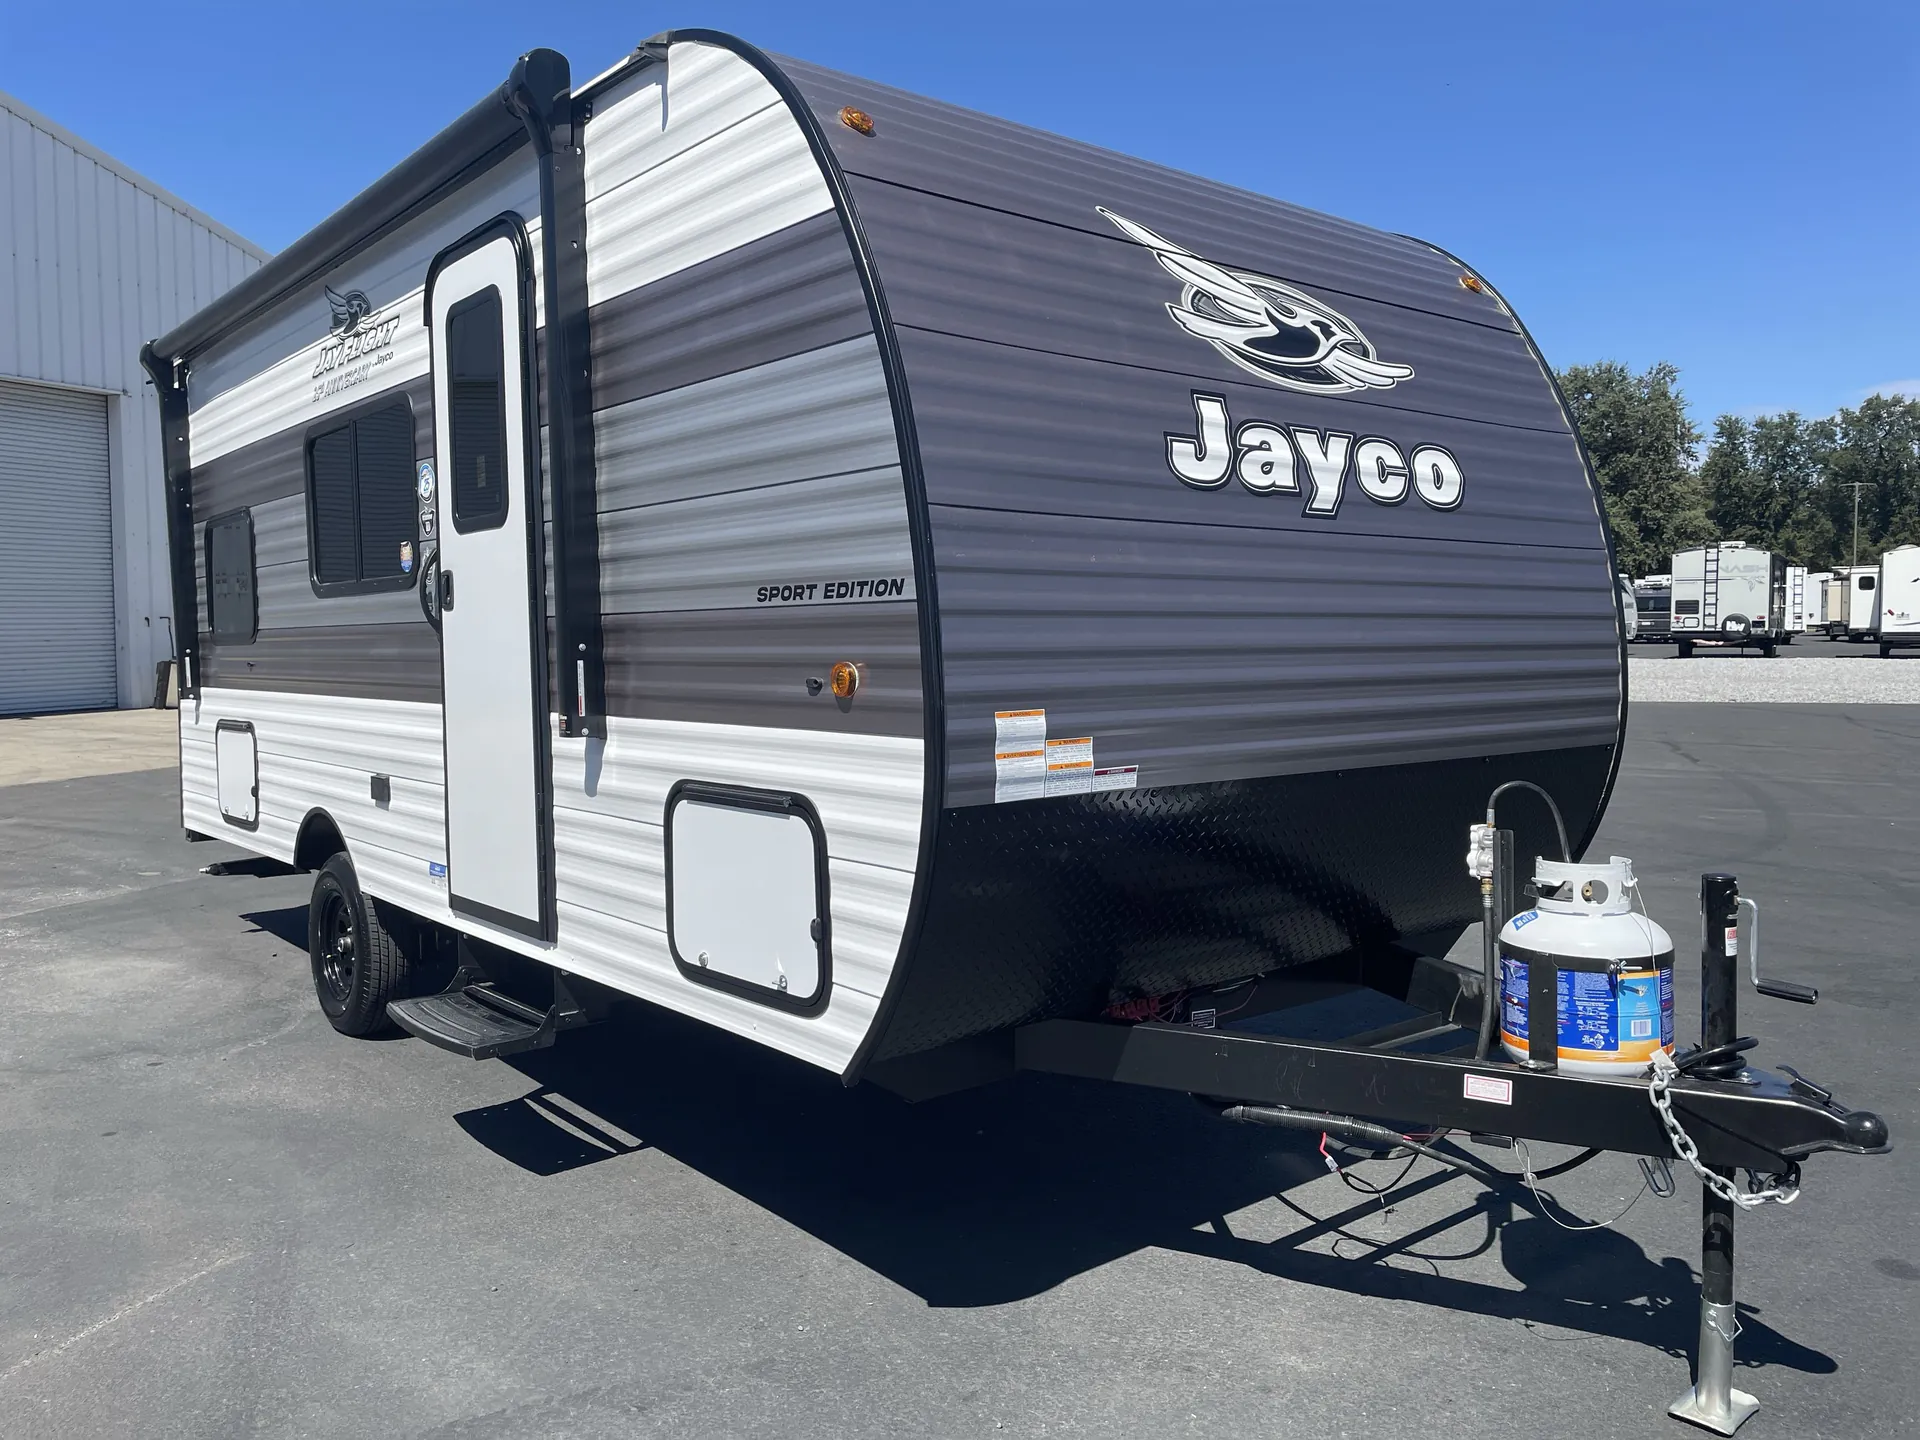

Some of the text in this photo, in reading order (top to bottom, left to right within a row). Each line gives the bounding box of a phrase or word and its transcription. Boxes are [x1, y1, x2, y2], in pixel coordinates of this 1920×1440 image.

[312, 314, 400, 379] JAY FLIGHT
[377, 351, 394, 366] Jayco
[1163, 389, 1466, 520] Jayco
[1719, 564, 1769, 574] NASH
[756, 578, 906, 603] SPORT EDITION
